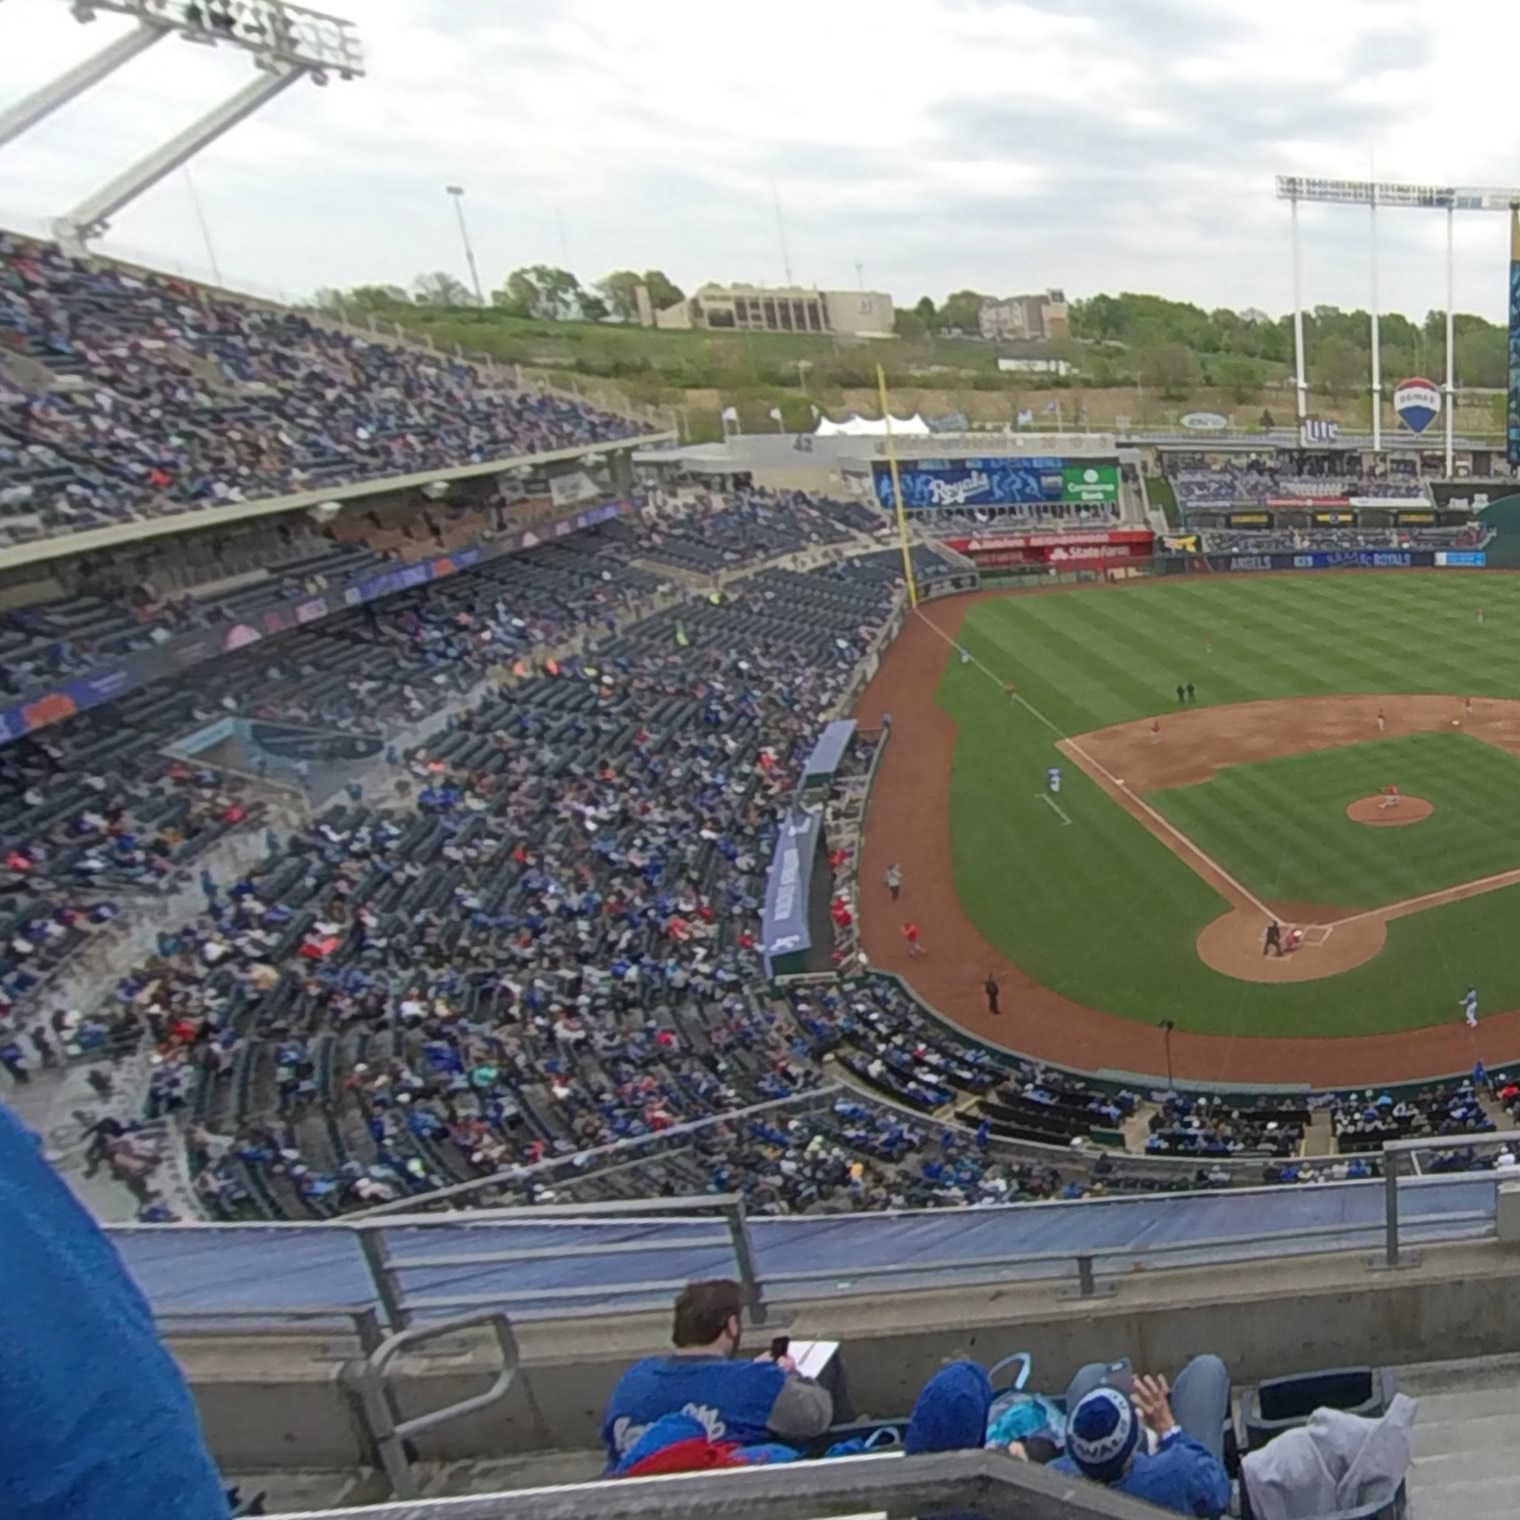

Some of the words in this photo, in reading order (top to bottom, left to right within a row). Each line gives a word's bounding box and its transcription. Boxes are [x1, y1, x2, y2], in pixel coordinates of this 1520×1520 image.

[929, 470, 990, 505] Royals
[1230, 556, 1272, 570] ANGELS
[1373, 553, 1411, 567] ROYALS
